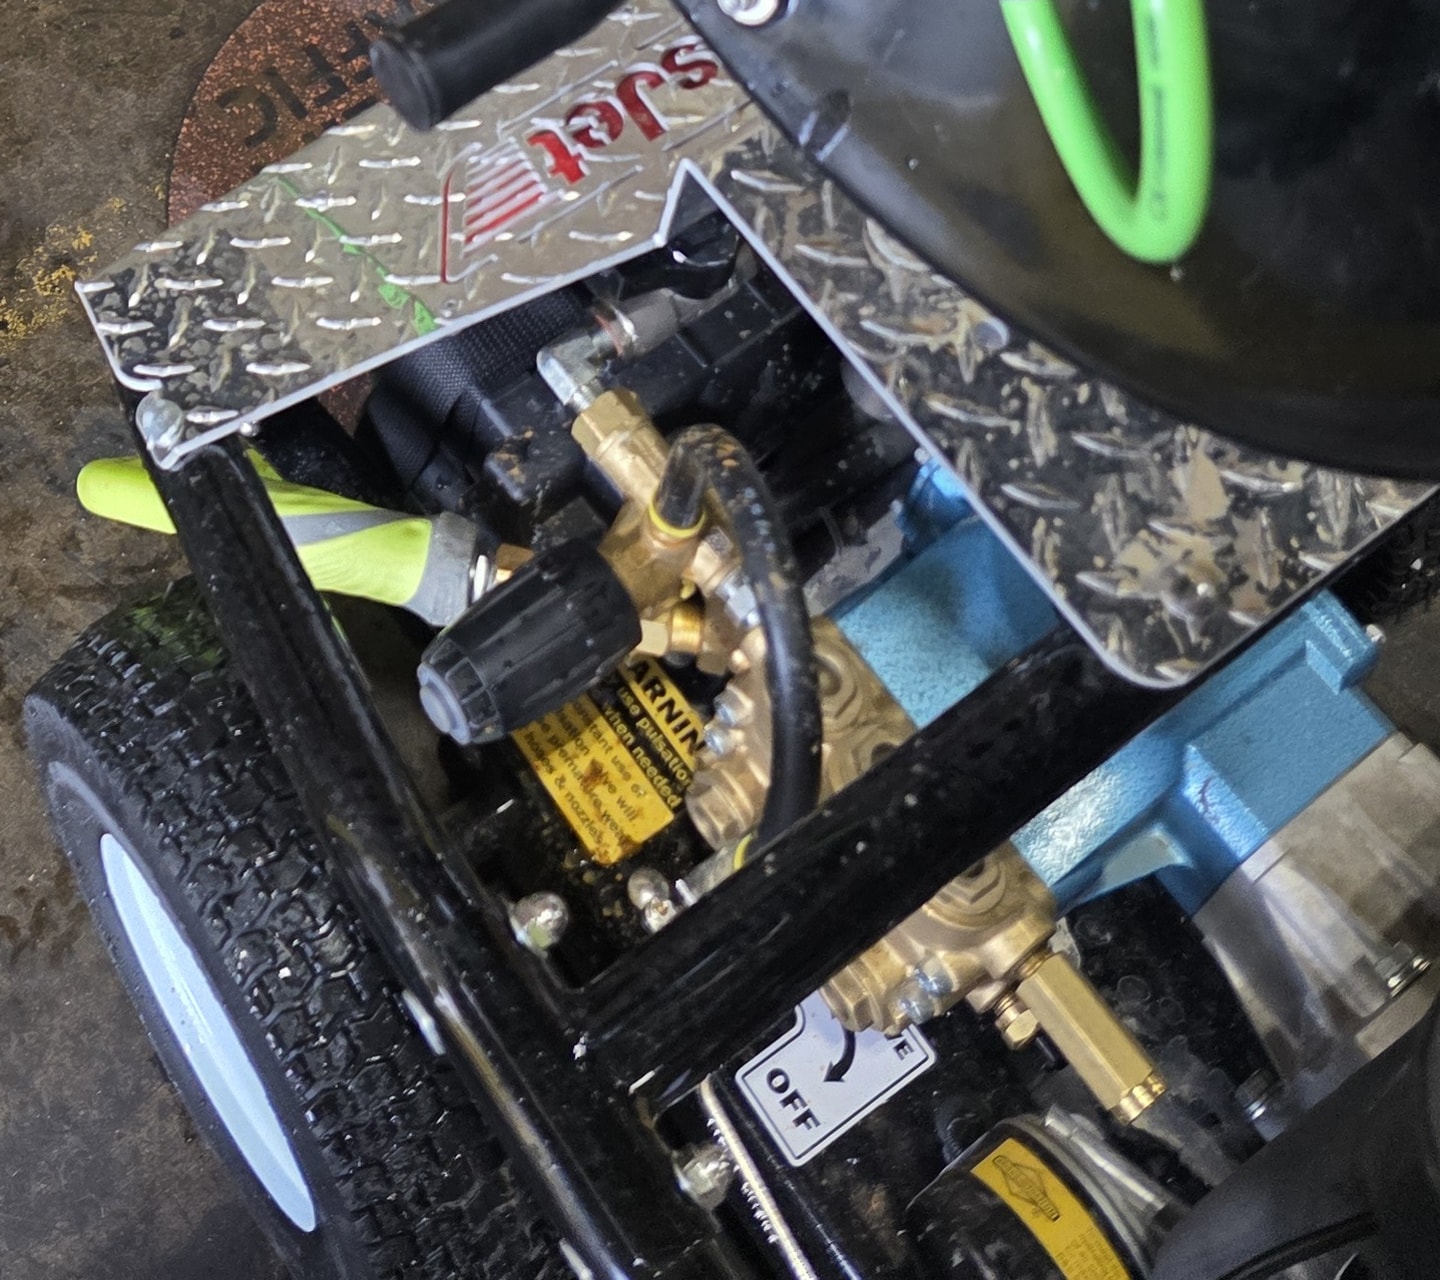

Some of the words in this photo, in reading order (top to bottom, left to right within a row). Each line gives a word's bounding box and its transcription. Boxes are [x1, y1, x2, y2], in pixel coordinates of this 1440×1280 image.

[627, 660, 707, 757] ARNIN
[614, 794, 639, 822] will
[630, 743, 683, 809] needed
[766, 1067, 821, 1131] OFF
